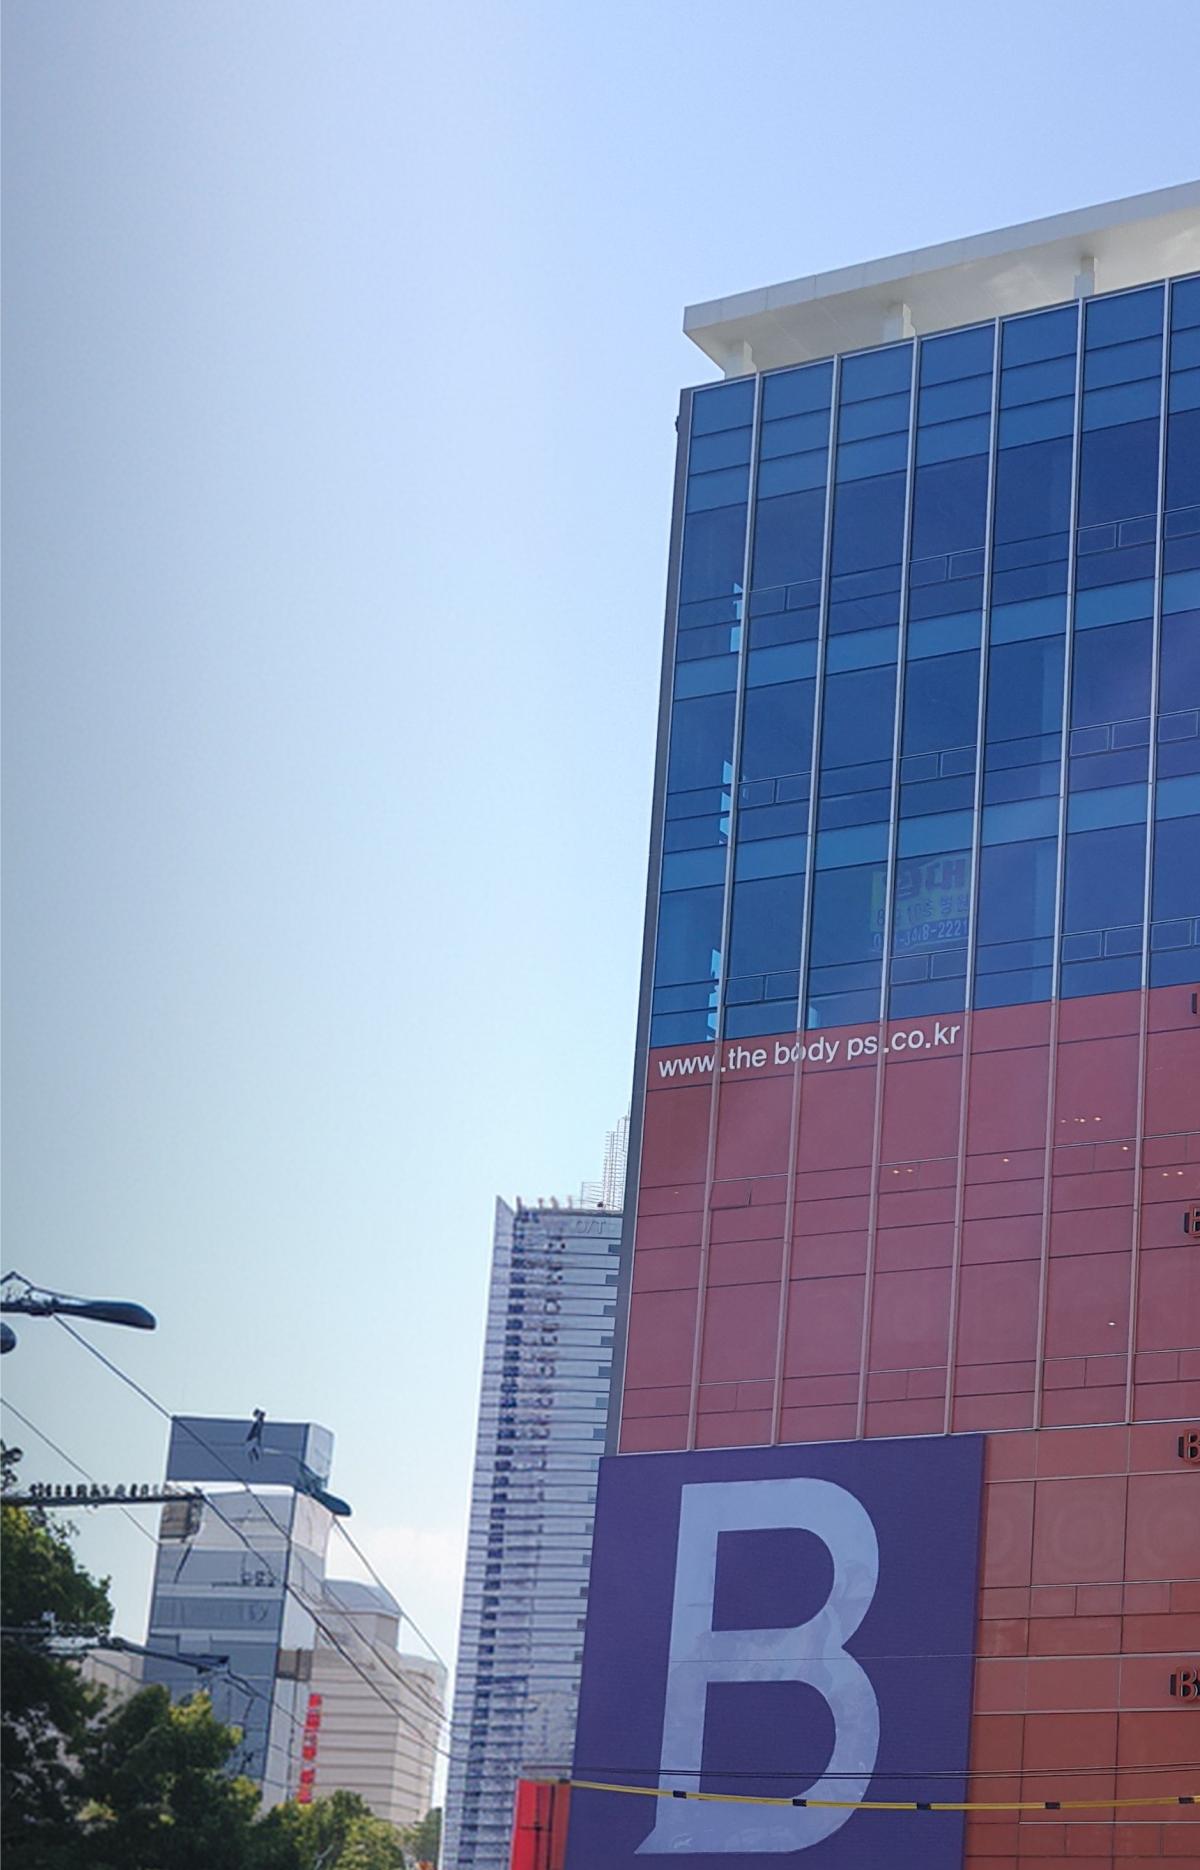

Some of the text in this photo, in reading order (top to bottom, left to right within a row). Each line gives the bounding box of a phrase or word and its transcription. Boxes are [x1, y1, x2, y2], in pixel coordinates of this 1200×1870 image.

[774, 1036, 840, 1067] body
[847, 1021, 961, 1061] ps.co.kr
[634, 1477, 881, 1855] B
